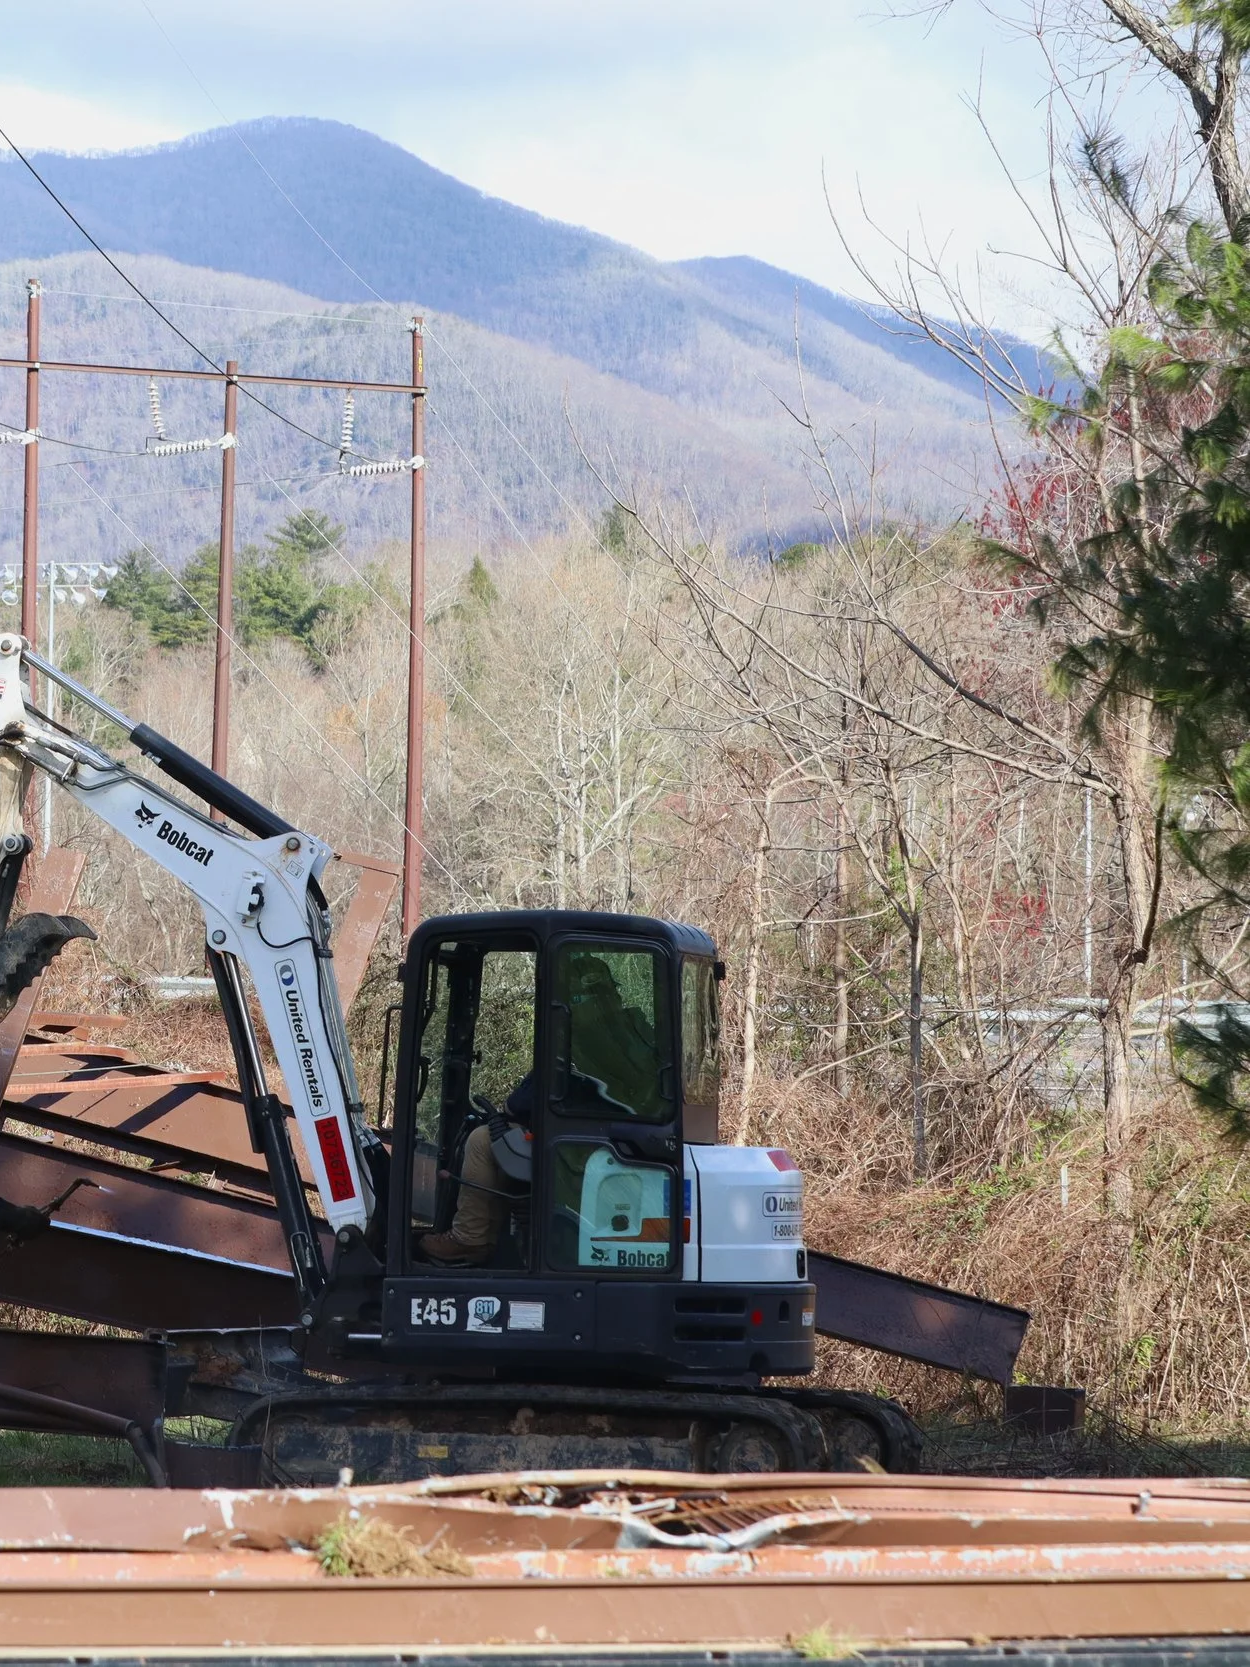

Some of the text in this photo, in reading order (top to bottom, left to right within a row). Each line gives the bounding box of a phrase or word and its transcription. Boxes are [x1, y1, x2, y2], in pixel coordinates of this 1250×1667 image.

[156, 820, 214, 867] Bobcat
[285, 990, 324, 1108] United Rentals
[411, 1298, 457, 1325] E45
[475, 1299, 494, 1315] 811
